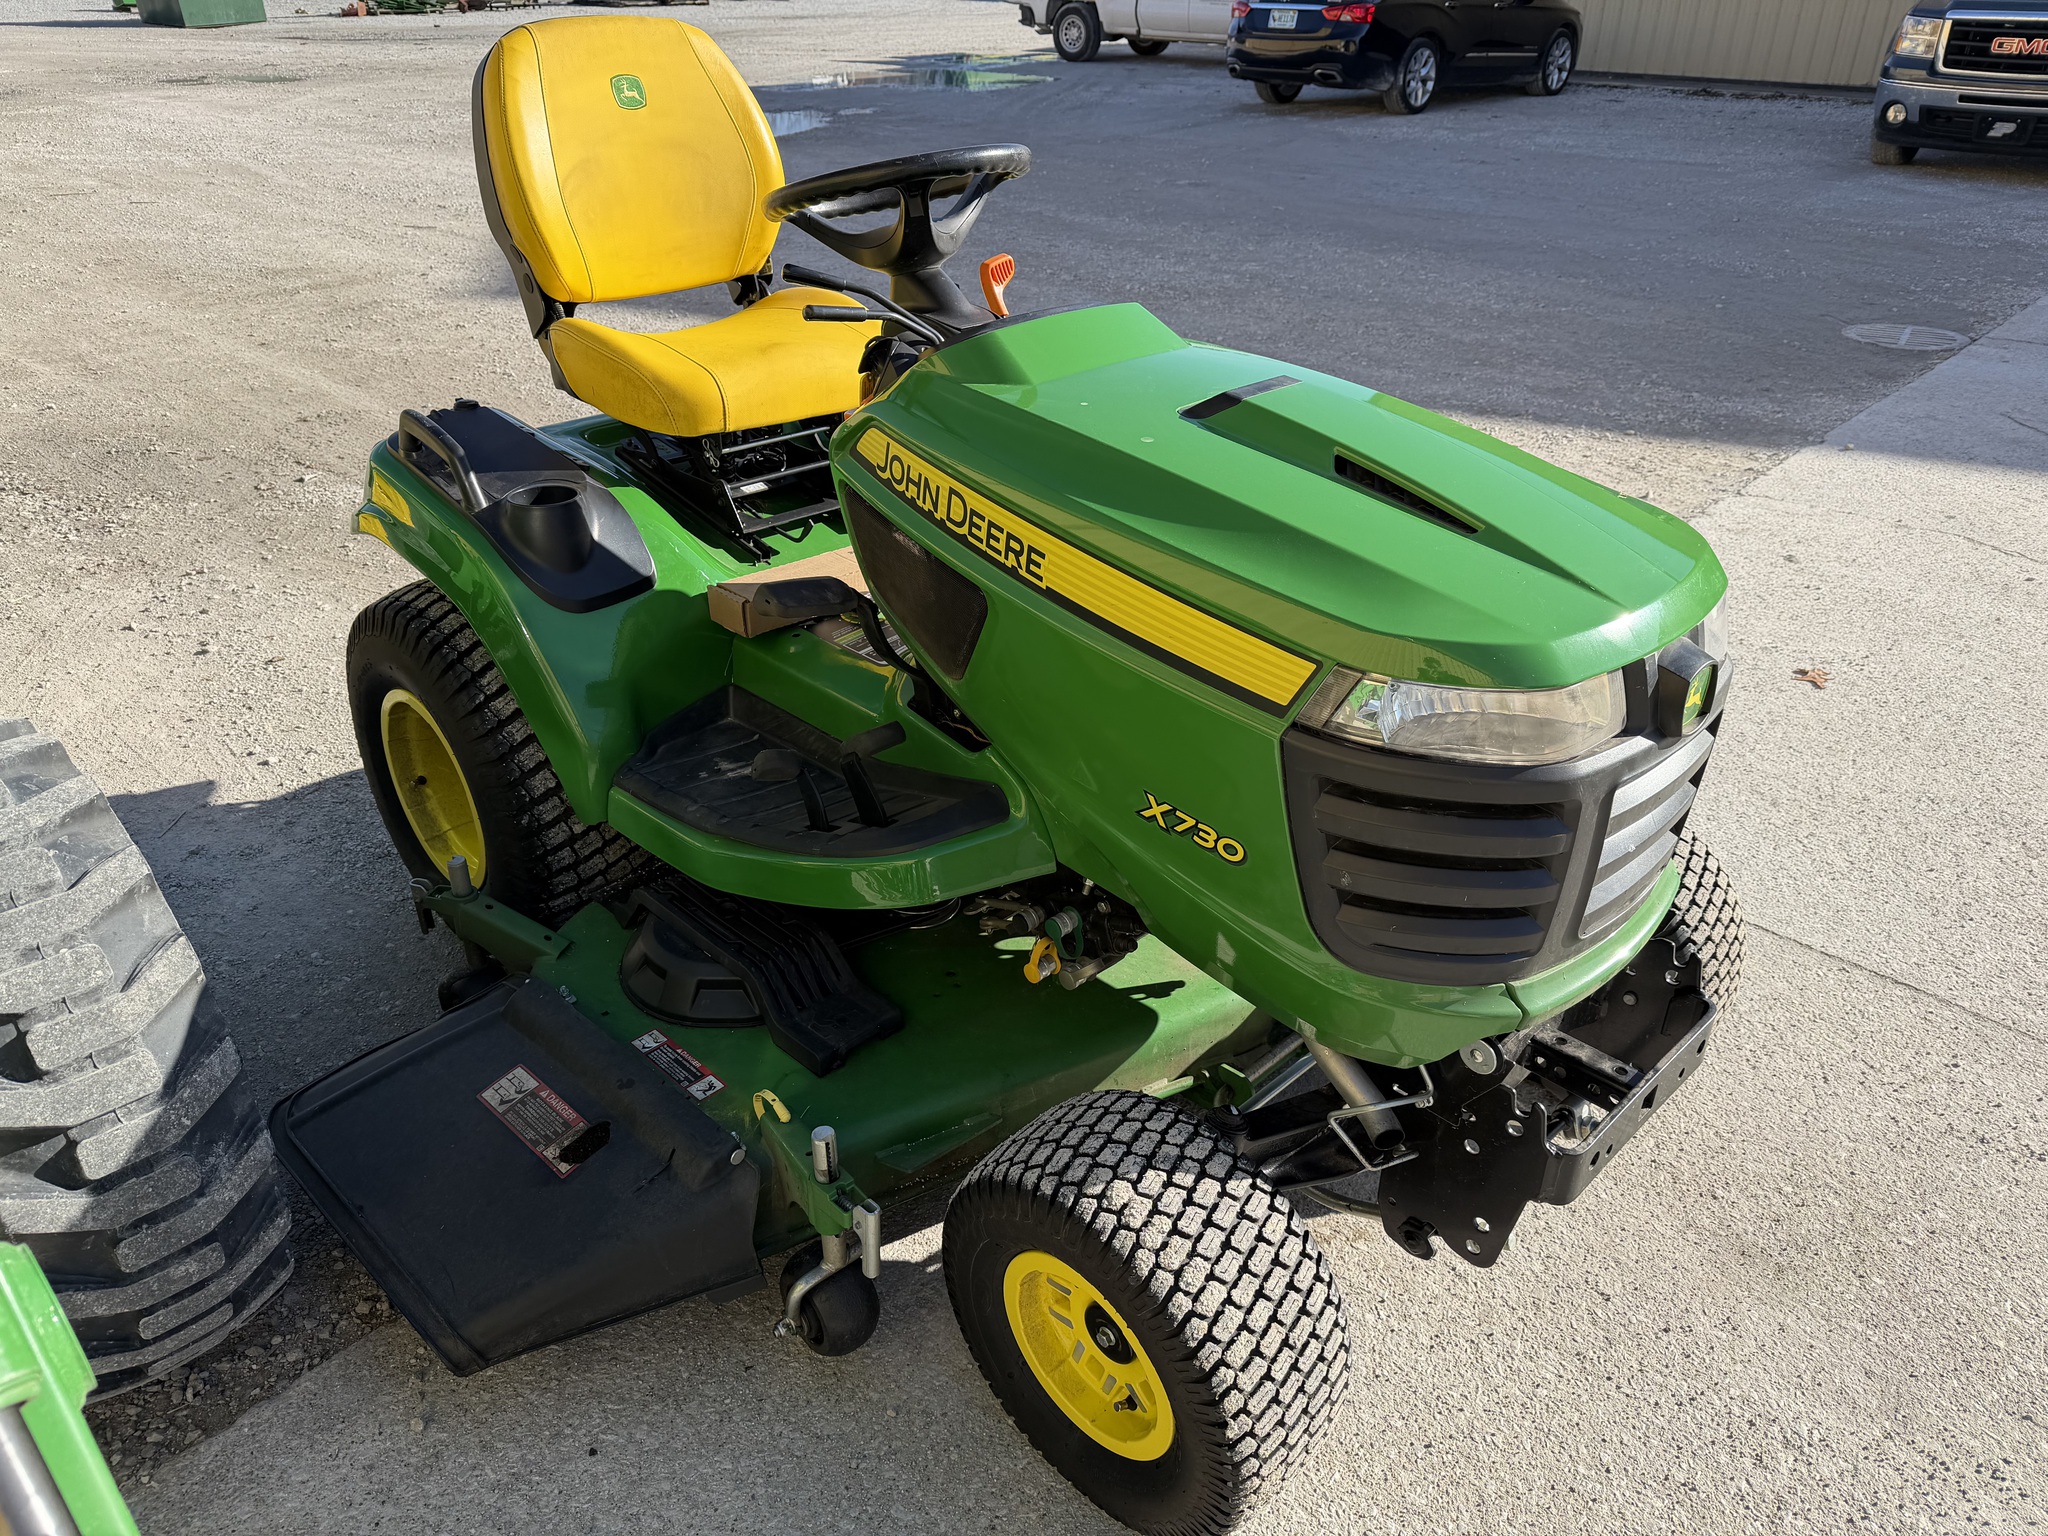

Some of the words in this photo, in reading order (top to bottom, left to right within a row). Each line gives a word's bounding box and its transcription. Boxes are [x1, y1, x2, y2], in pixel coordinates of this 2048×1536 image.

[876, 442, 941, 515] JOHN
[946, 485, 1047, 583] DEERE
[1135, 789, 1248, 866] X730
[680, 1049, 703, 1069] DANGER
[546, 1094, 577, 1122] DANGER
